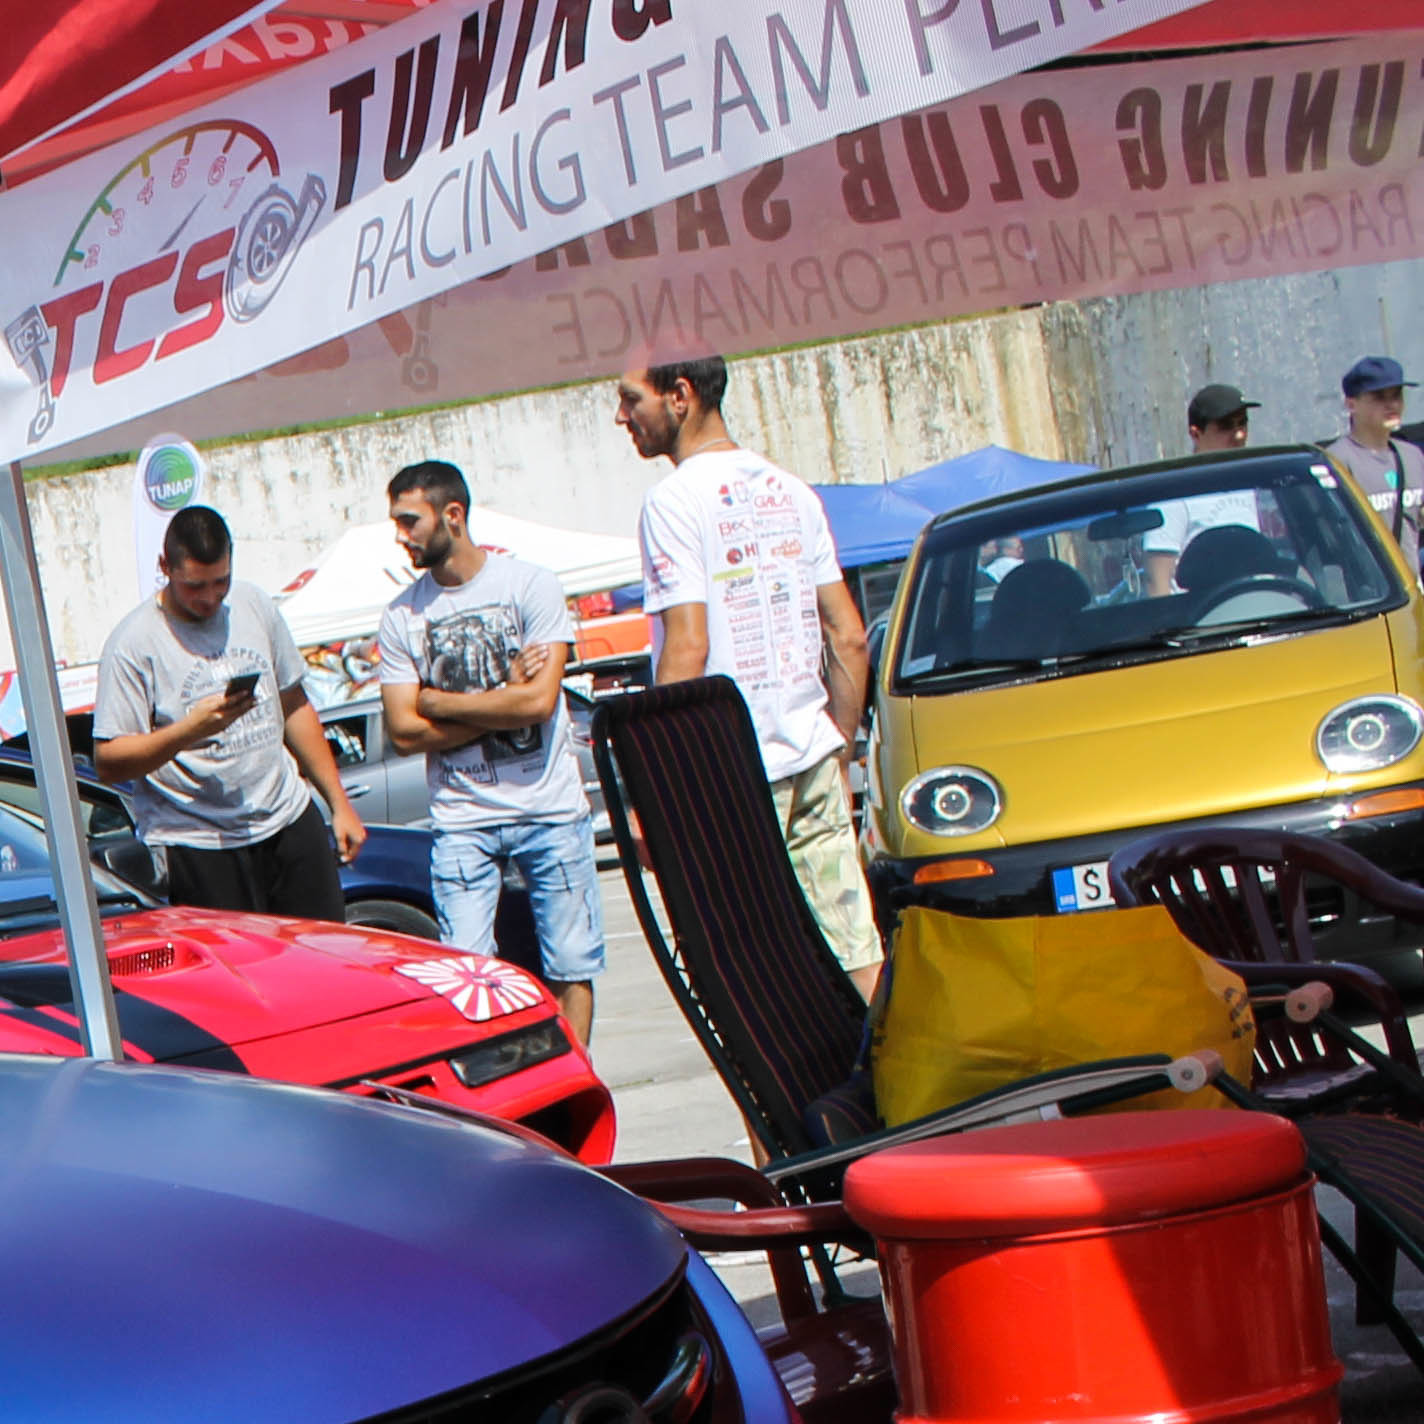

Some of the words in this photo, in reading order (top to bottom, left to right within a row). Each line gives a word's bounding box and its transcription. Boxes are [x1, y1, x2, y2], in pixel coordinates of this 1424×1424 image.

[347, 107, 588, 311] RACING
[592, 0, 872, 187] TEAM
[39, 226, 236, 399] TCS
[148, 478, 194, 502] TUNAP
